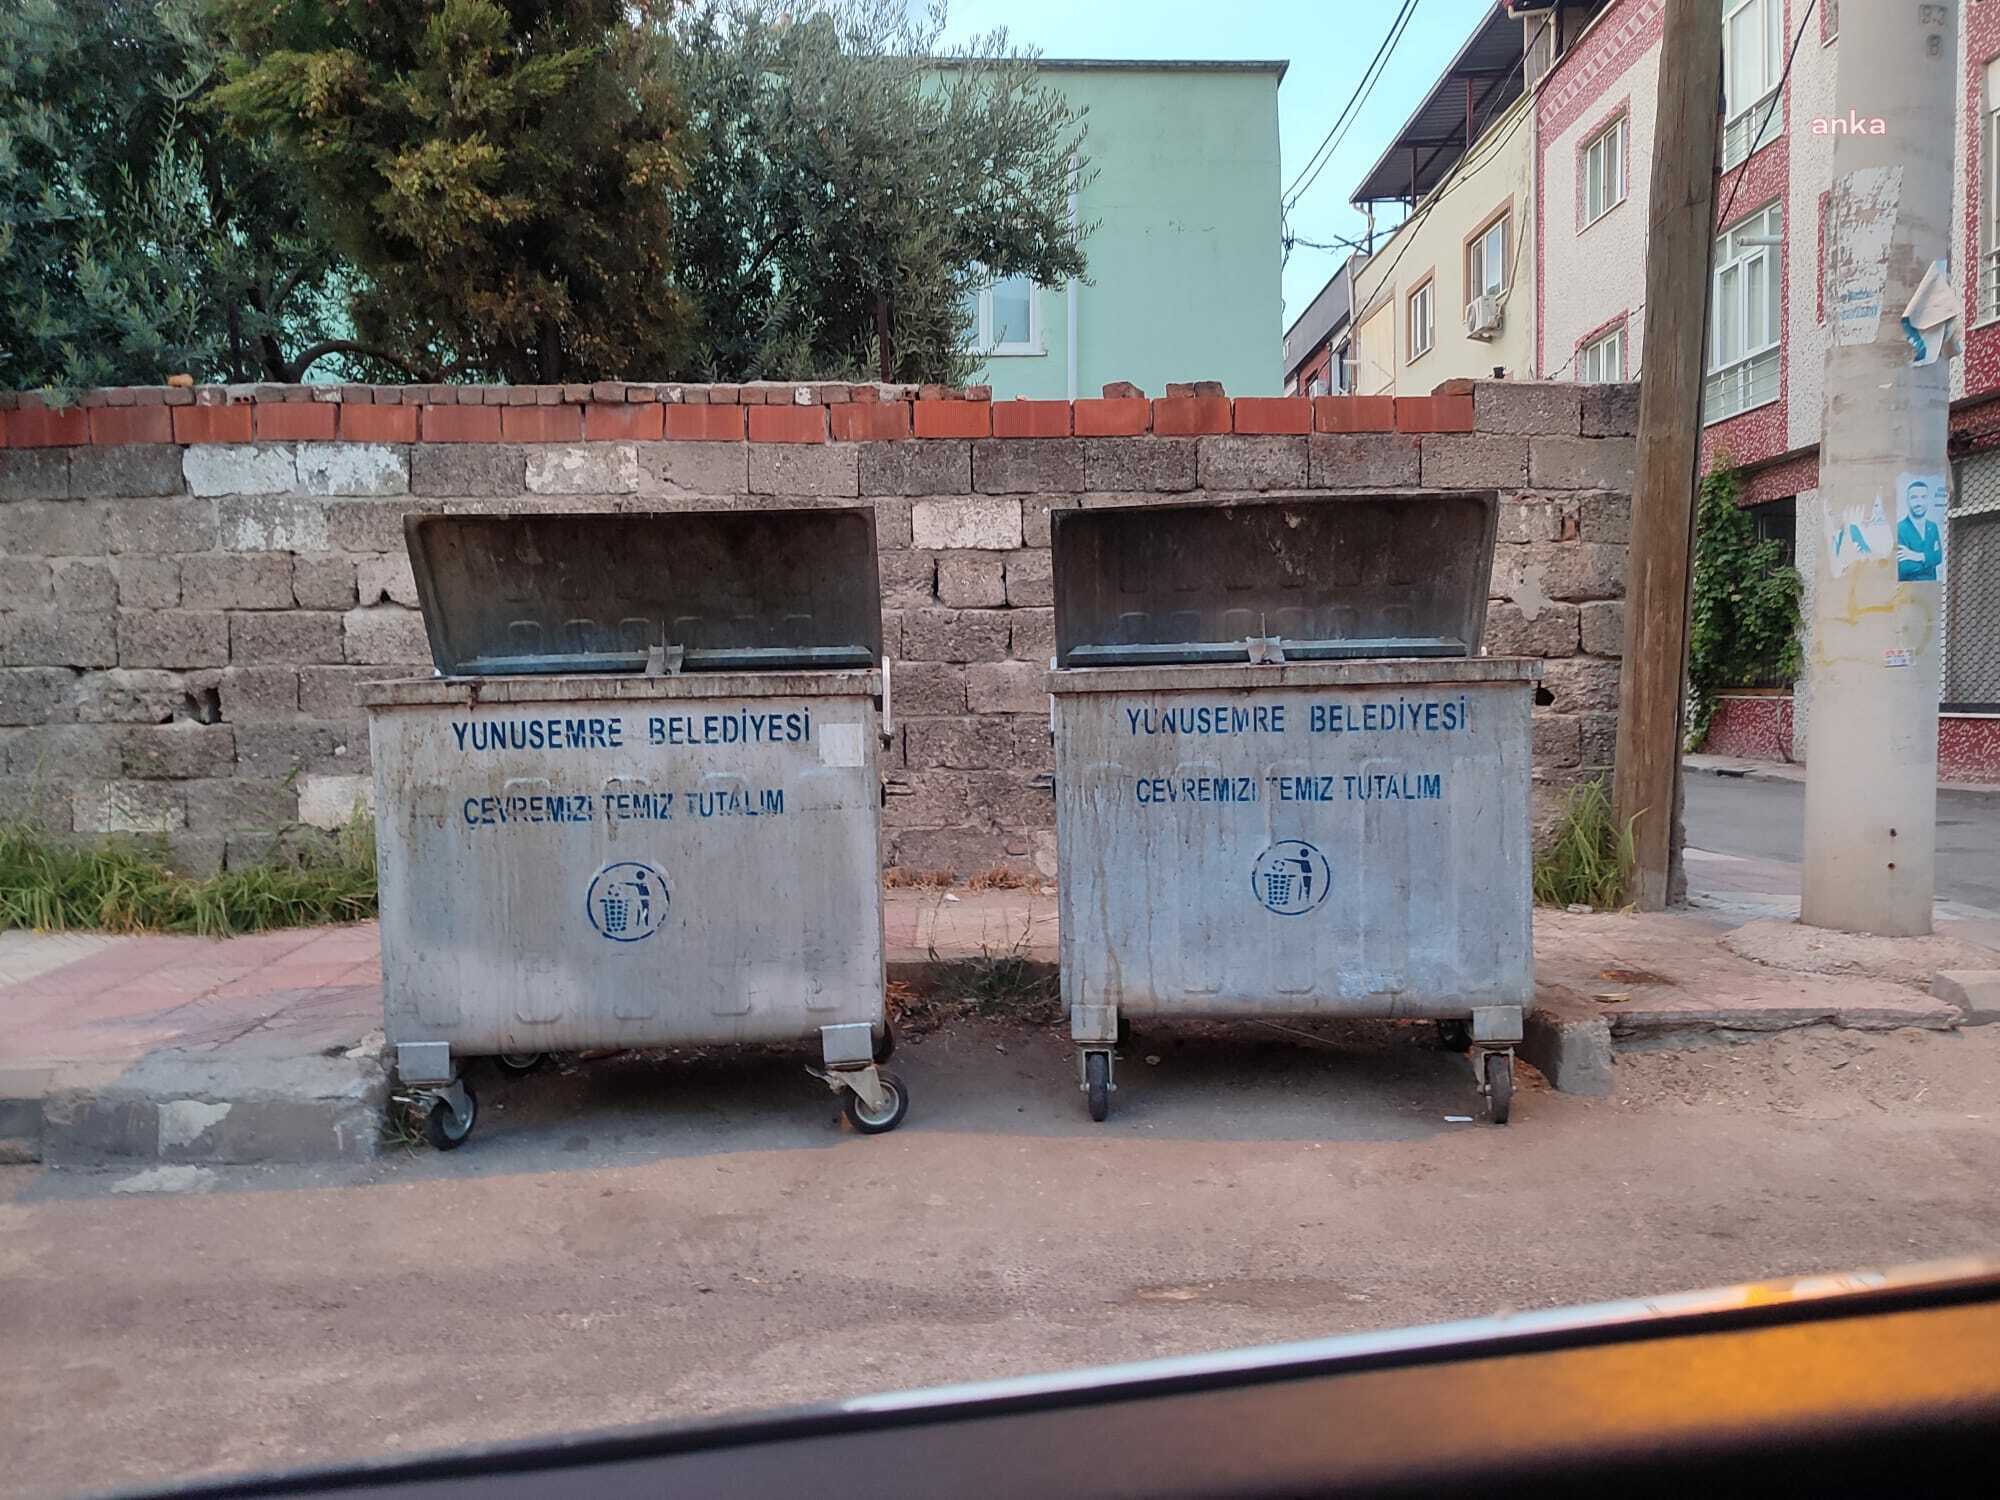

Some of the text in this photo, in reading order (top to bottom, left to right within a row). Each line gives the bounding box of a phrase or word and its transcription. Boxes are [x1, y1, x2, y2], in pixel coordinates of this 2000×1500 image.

[453, 706, 811, 751] YUNUSEMRE BELEDİYESİ
[1126, 695, 1466, 736] YUNUSEMRE BELEDİYESİ
[463, 788, 784, 830] ÇEVREMİZİ TEMİZ TUTALIM
[1135, 776, 1257, 807] ÇEVREMİZİ
[1343, 773, 1442, 801] TUTALIM
